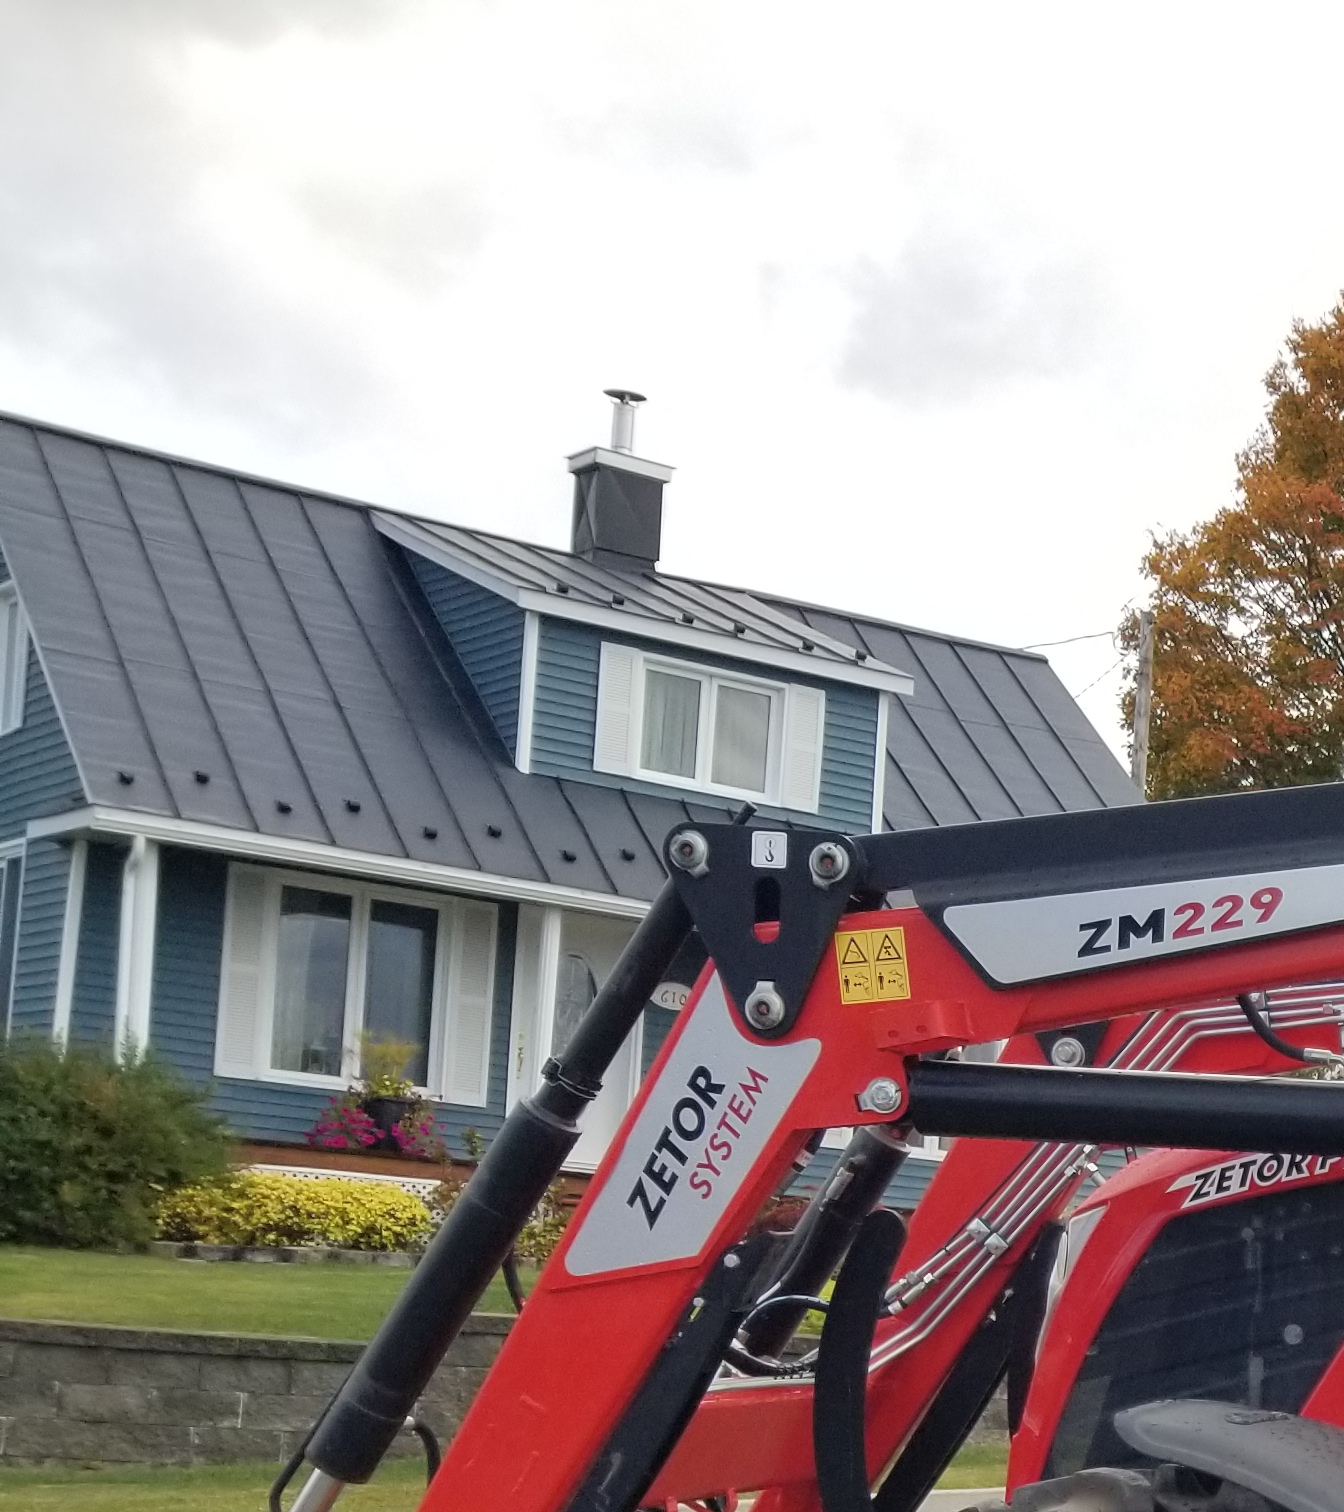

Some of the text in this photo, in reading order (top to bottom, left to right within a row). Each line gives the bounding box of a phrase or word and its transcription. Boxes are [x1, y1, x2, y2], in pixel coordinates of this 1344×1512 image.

[1076, 886, 1284, 958] ZM229
[626, 1065, 726, 1231] ZETOR
[689, 1066, 769, 1200] SYSTEM
[1188, 1151, 1309, 1204] ZETOR
